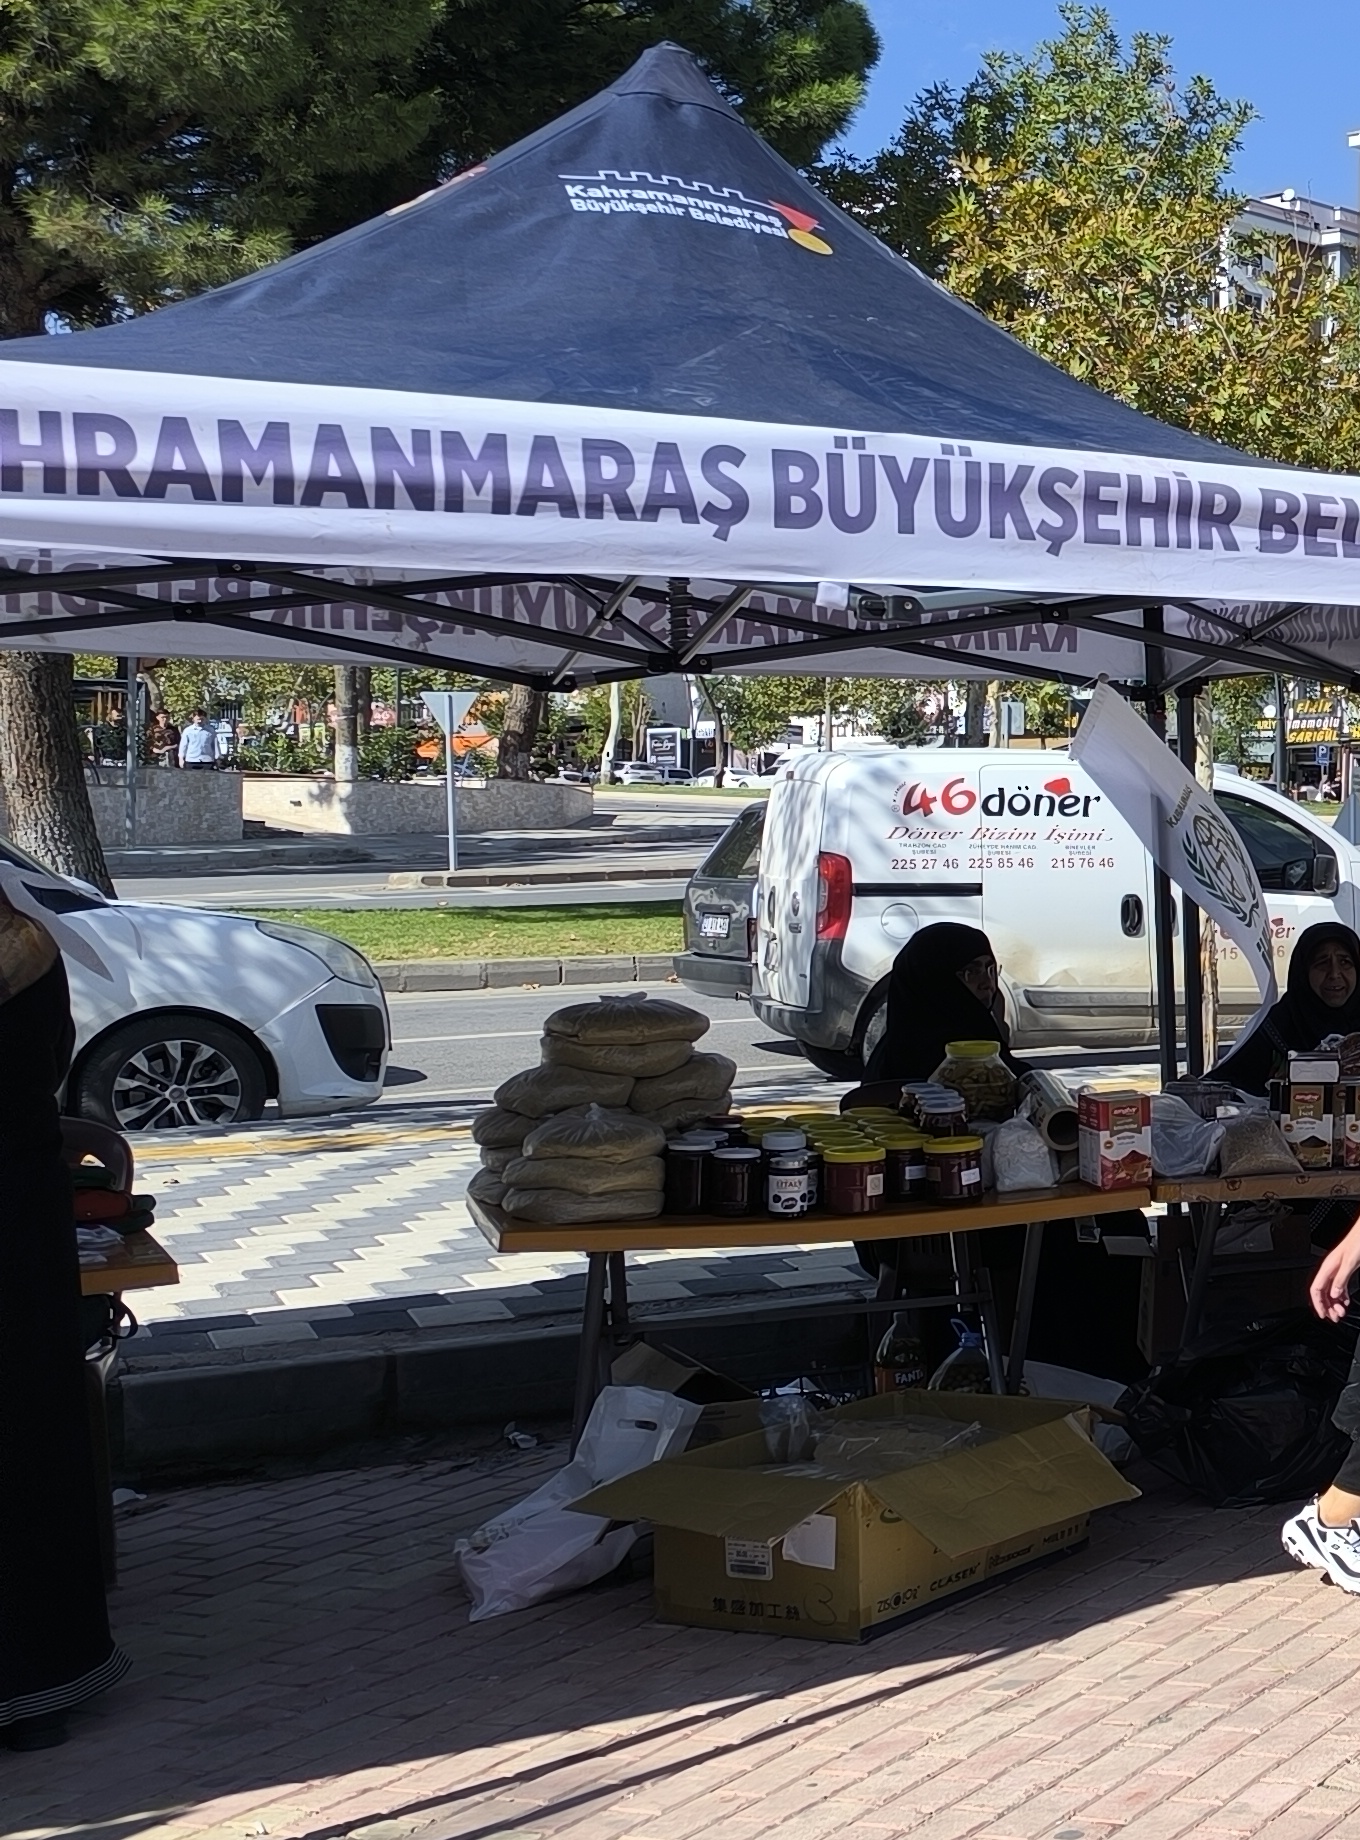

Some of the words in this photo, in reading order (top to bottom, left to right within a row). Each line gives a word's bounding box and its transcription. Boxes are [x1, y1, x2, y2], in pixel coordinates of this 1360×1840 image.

[565, 184, 783, 228] Kahramanmaraş
[569, 198, 686, 217] Büyükşehir
[688, 206, 790, 239] Belediyesi
[0, 408, 750, 542] HRAMANMARAŞ
[771, 435, 1240, 557] BÜYÜKŞEHİR
[903, 778, 977, 817] 46
[981, 785, 1101, 818] döner
[885, 826, 964, 840] Döner
[968, 827, 1037, 841] Bizim
[891, 858, 917, 870] 225
[921, 858, 938, 870] 27
[942, 858, 959, 870] 46
[968, 858, 993, 869] 225
[997, 858, 1014, 869] 85
[1018, 858, 1034, 869] 46
[1051, 858, 1075, 869] 215
[1079, 858, 1095, 869] 76
[1099, 858, 1115, 869] 46
